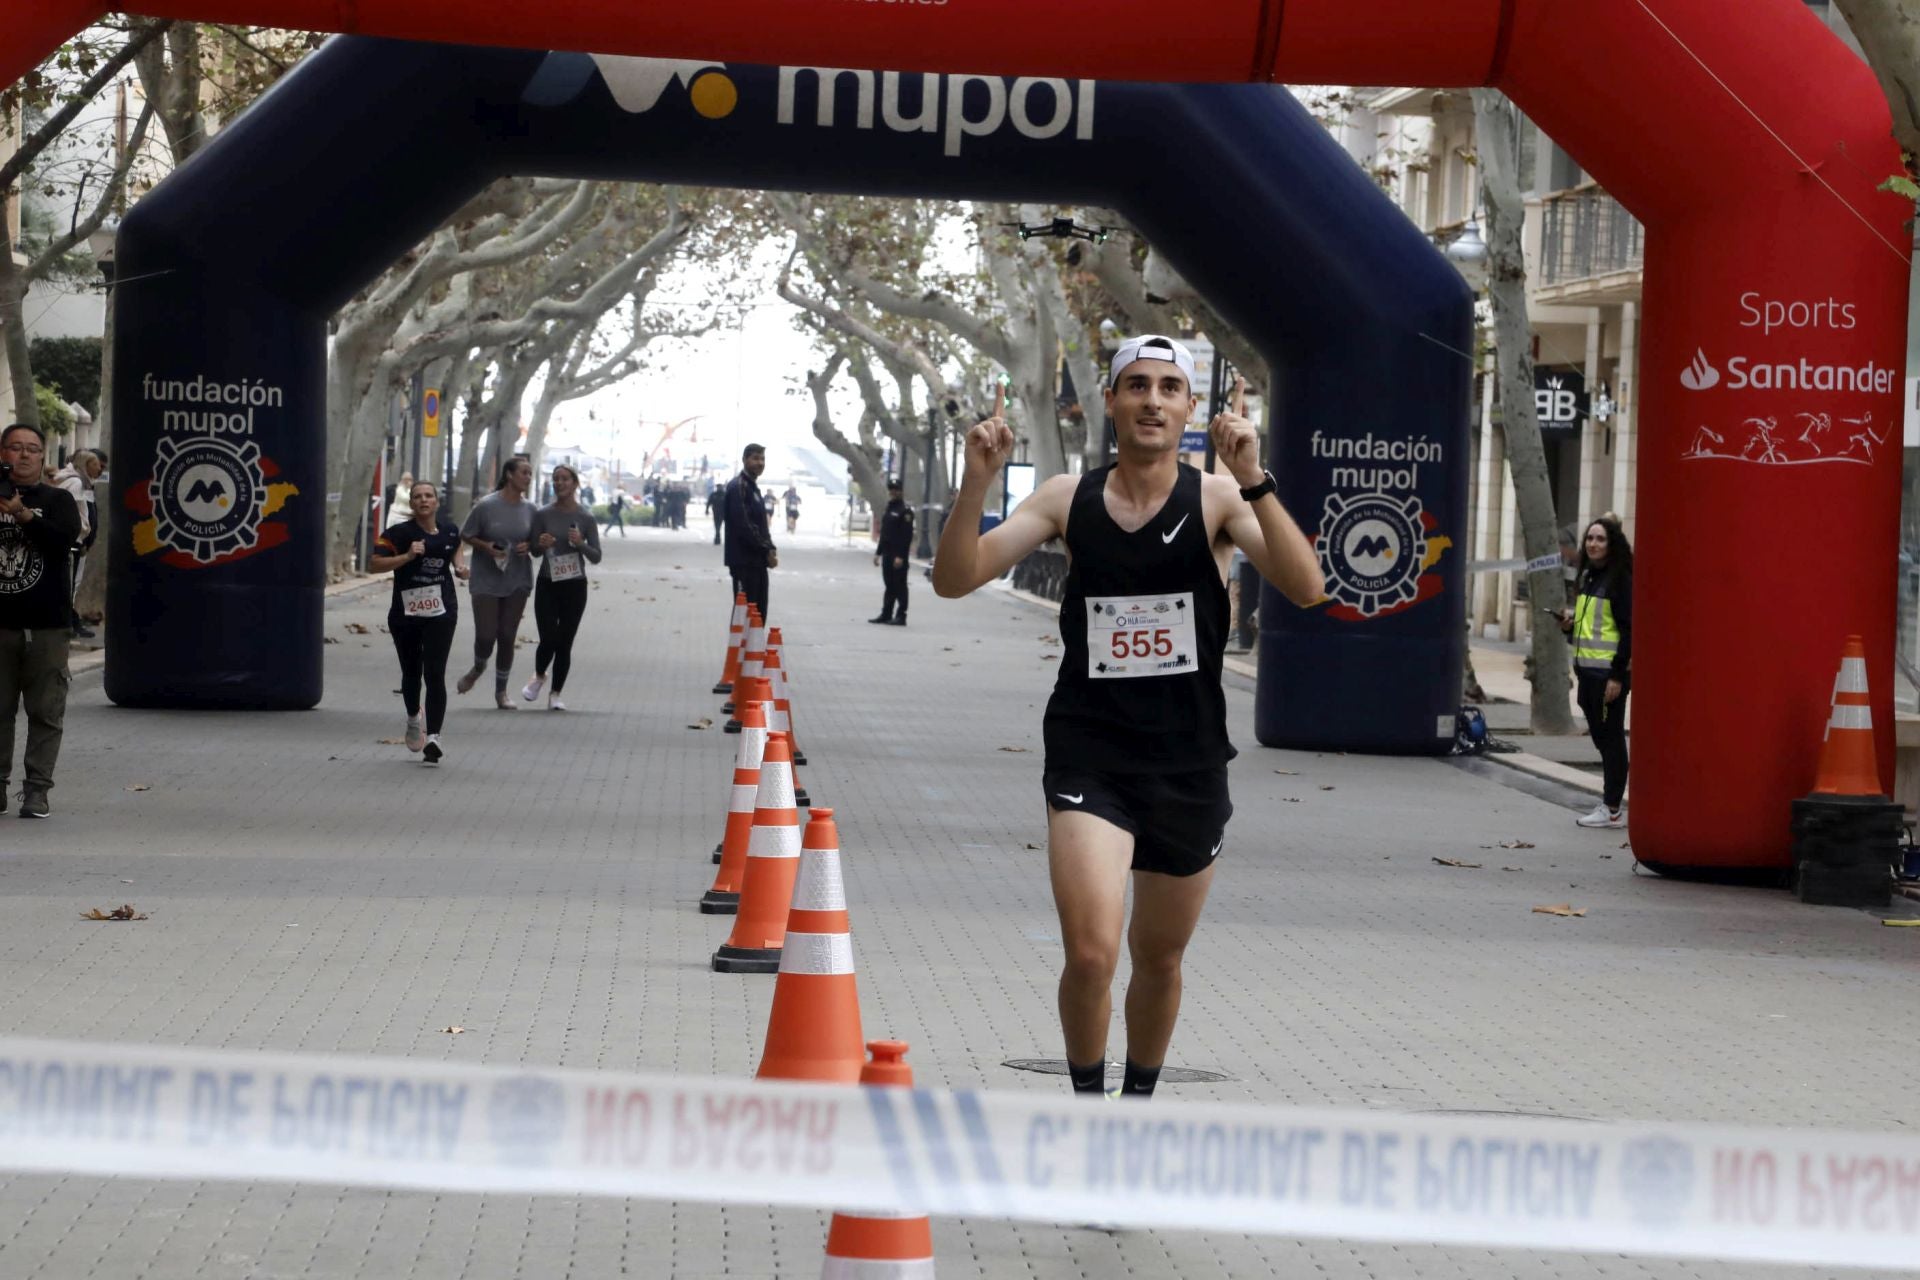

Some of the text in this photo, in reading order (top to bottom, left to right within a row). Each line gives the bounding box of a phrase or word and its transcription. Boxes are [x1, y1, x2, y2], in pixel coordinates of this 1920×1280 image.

[777, 65, 1096, 157] mupol
[1740, 291, 1856, 336] Sports
[142, 372, 283, 408] fundación
[1726, 356, 1896, 394] Santander
[163, 408, 254, 439] mupol
[1310, 430, 1442, 463] fundación
[1332, 464, 1418, 496] mupol
[184, 520, 228, 535] POLICÍA
[1350, 574, 1391, 590] POLICÍA
[409, 598, 440, 613] 2490
[1111, 629, 1173, 659] 555
